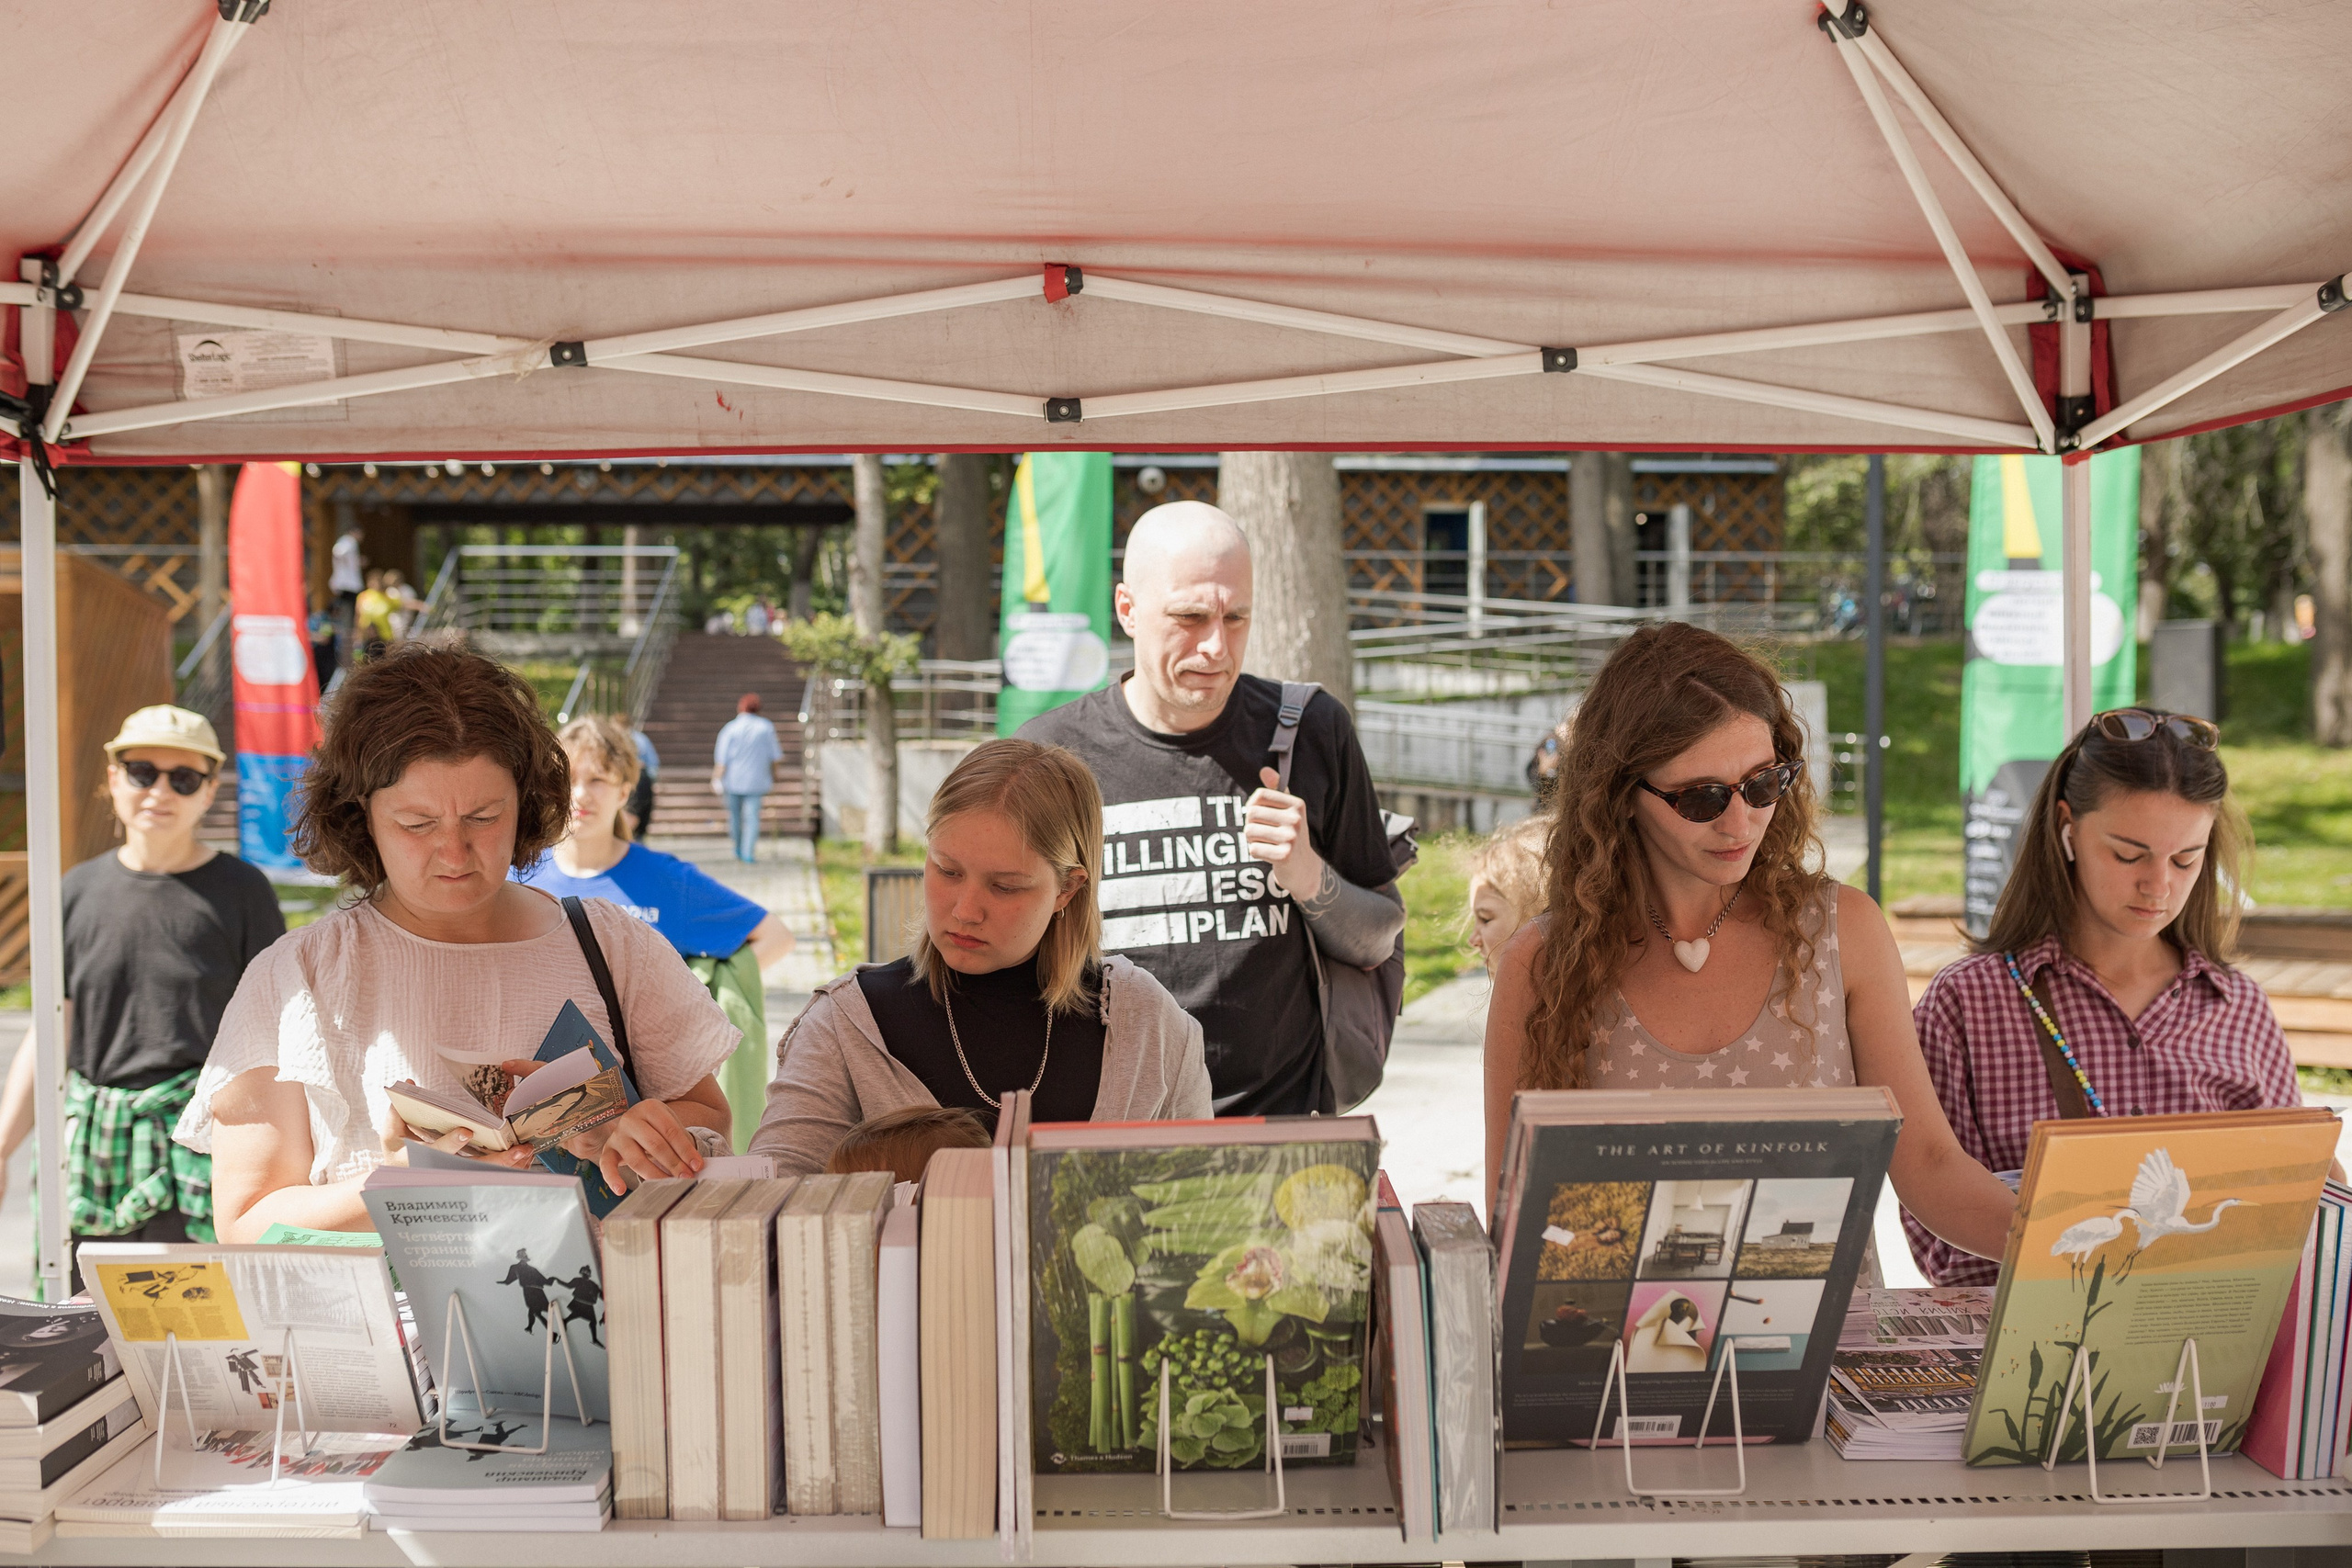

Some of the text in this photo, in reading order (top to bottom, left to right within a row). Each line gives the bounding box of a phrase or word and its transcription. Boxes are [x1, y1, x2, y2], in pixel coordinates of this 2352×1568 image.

[1189, 904, 1289, 943] PLAN
[1596, 1142, 1829, 1156] THE ART OF KINFOLK
[384, 1200, 469, 1214] Владимир
[390, 1212, 490, 1227] Кричевский
[397, 1231, 481, 1246] Четвёртая
[403, 1246, 479, 1259] страница
[409, 1258, 478, 1269] обложки
[1070, 1453, 1098, 1461] Thames
